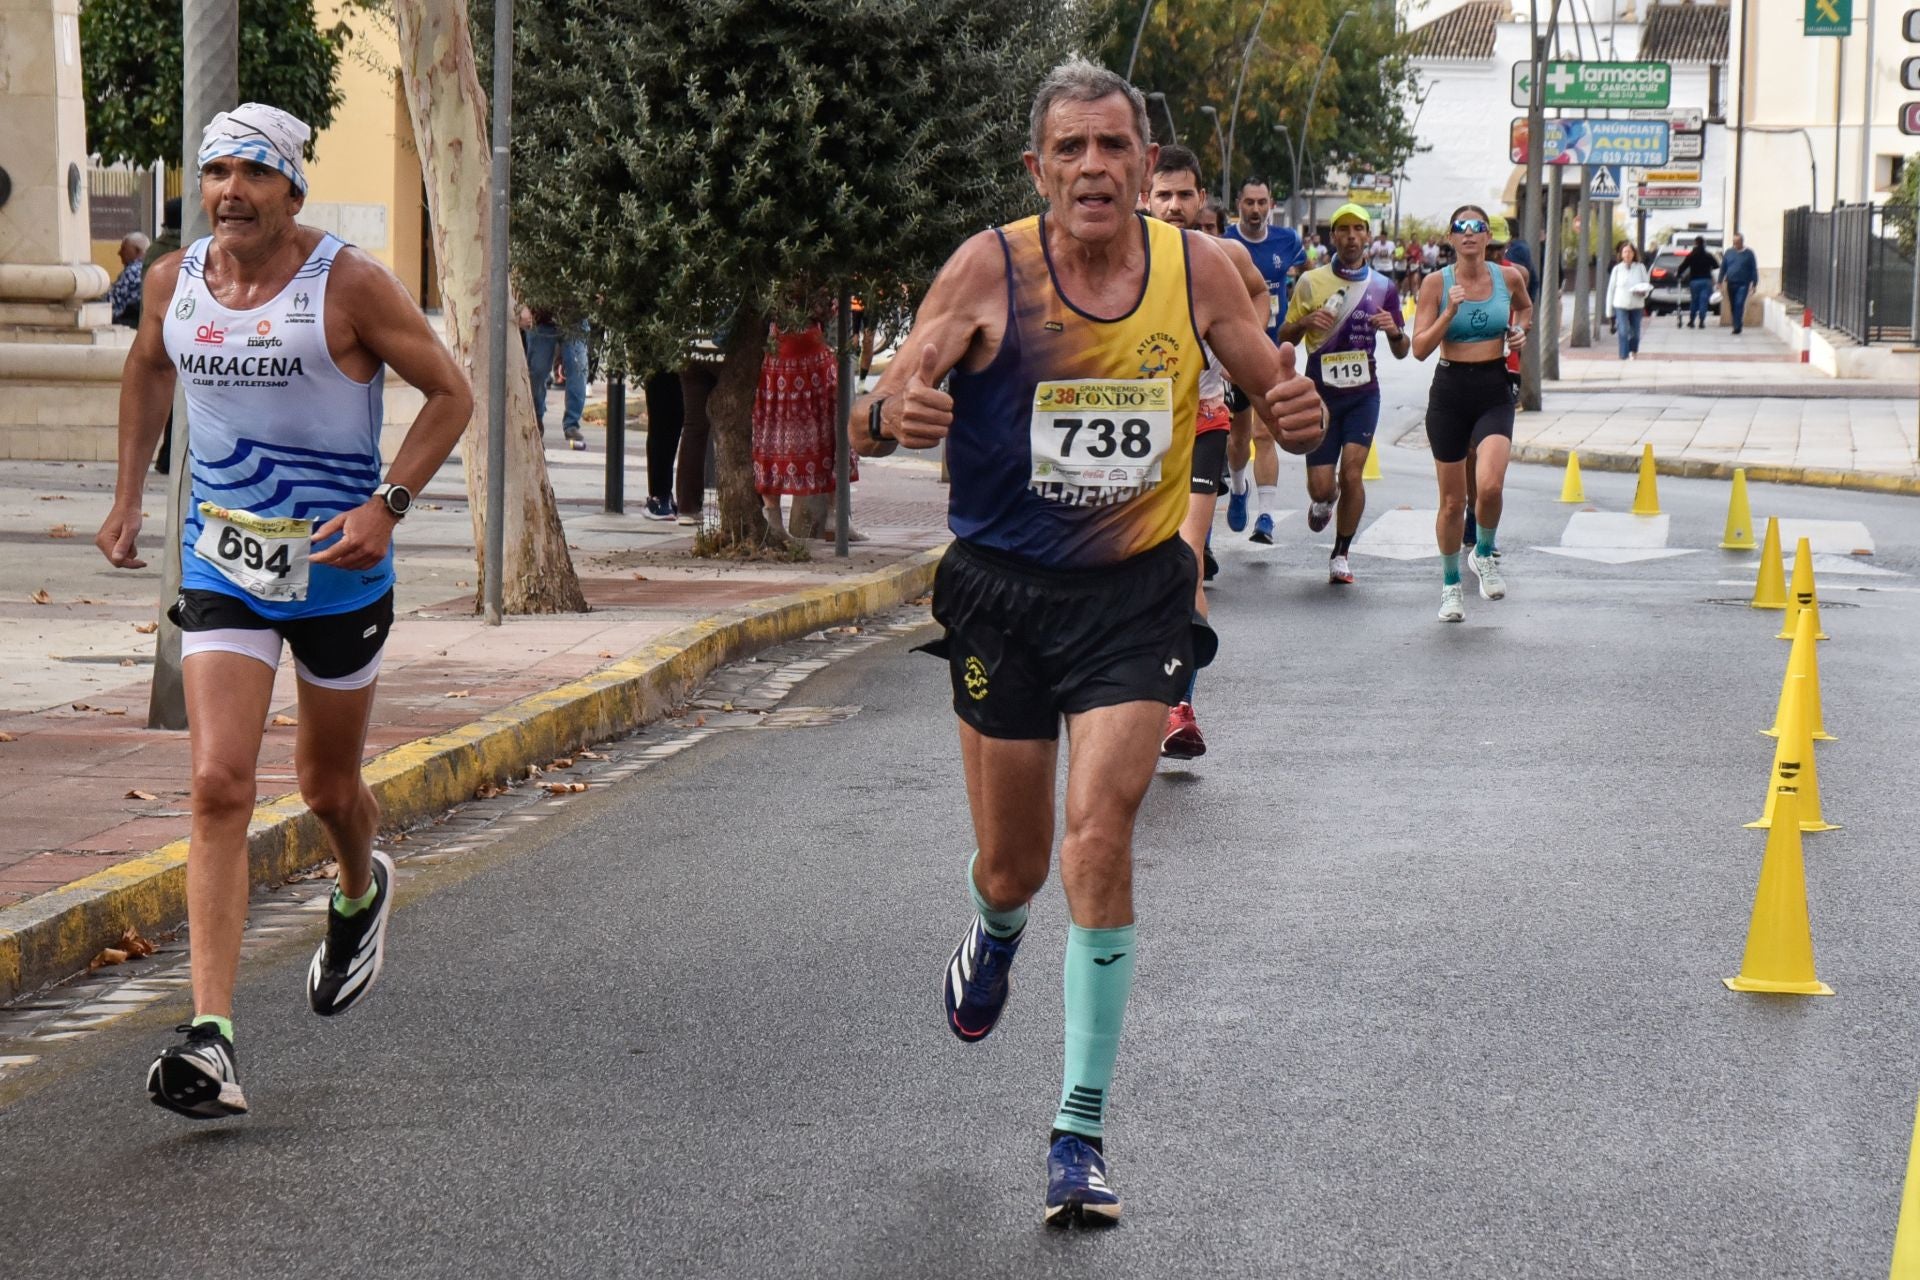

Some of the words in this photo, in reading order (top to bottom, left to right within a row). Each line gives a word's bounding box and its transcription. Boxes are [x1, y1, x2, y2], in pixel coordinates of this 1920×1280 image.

[1578, 64, 1666, 82] farmacia
[1593, 122, 1664, 135] ANÚNCIATE
[1595, 136, 1660, 151] AQUÍ
[247, 337, 283, 349] mayfo
[1137, 333, 1179, 356] ATLETISMO
[180, 353, 304, 377] MARACENA
[1329, 363, 1363, 379] 119
[192, 378, 214, 387] CLUB
[232, 380, 289, 388] ATLETISMO
[1055, 388, 1075, 404] 38
[1075, 392, 1146, 406] FONDO
[1053, 418, 1151, 458] 738
[217, 526, 291, 578] 694
